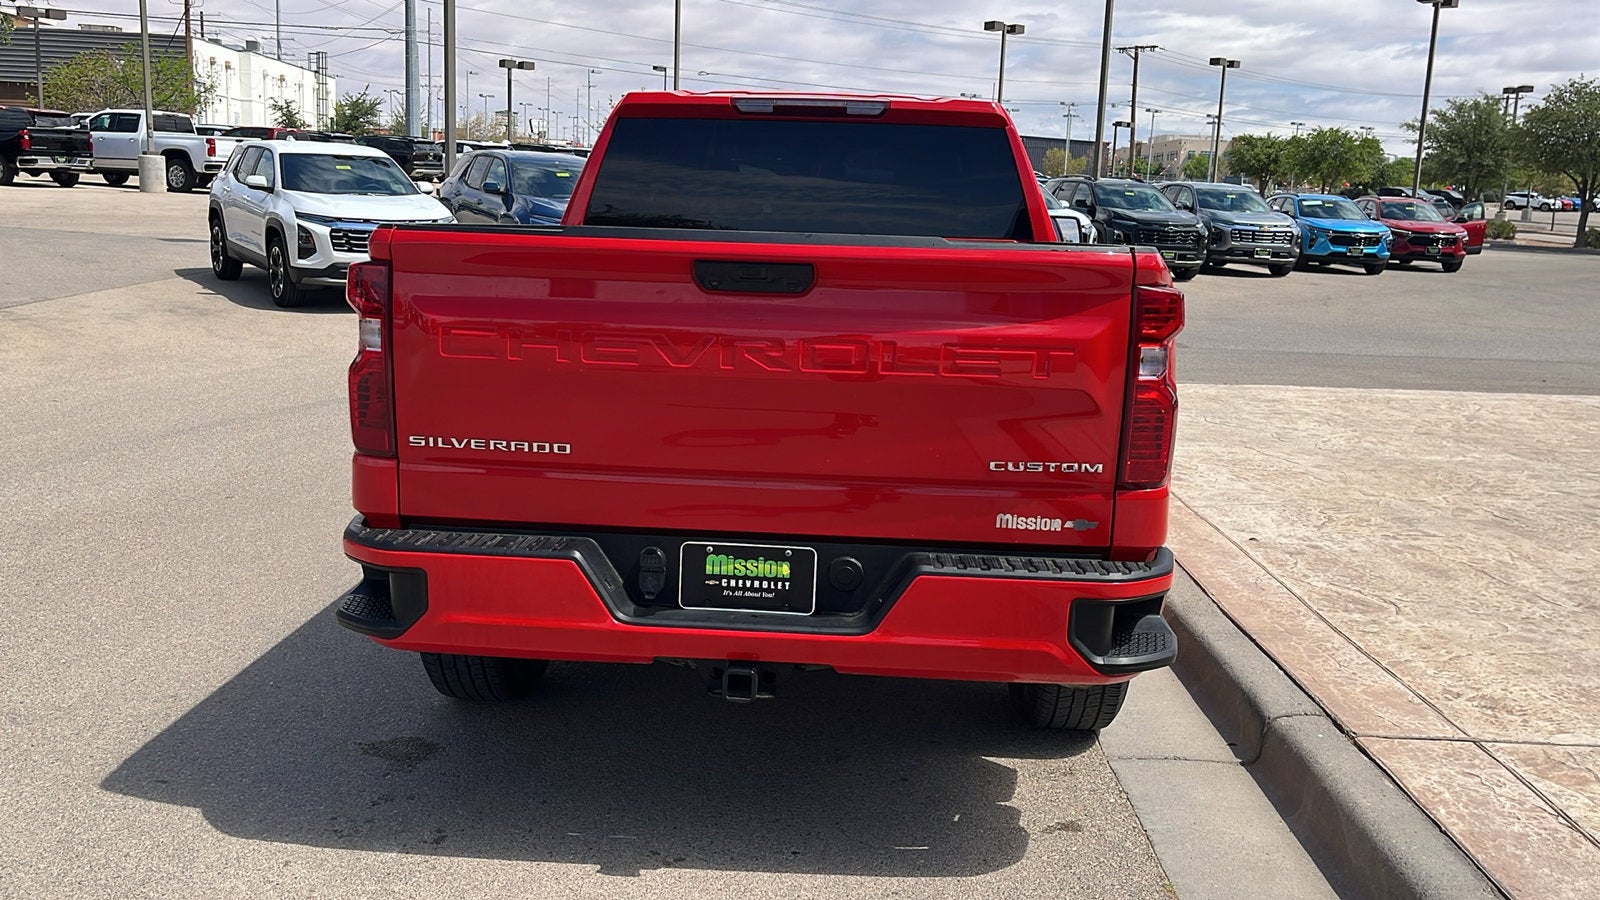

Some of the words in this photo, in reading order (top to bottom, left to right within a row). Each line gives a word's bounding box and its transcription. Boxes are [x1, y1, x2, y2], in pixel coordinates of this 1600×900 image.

[438, 326, 1077, 379] CHEVROLET
[409, 436, 571, 454] SILVERADO
[989, 461, 1103, 473] CUSTOM
[996, 513, 1062, 531] Mission
[705, 554, 790, 577] Mission
[721, 579, 791, 589] CHEVROLET
[743, 590, 761, 598] About
